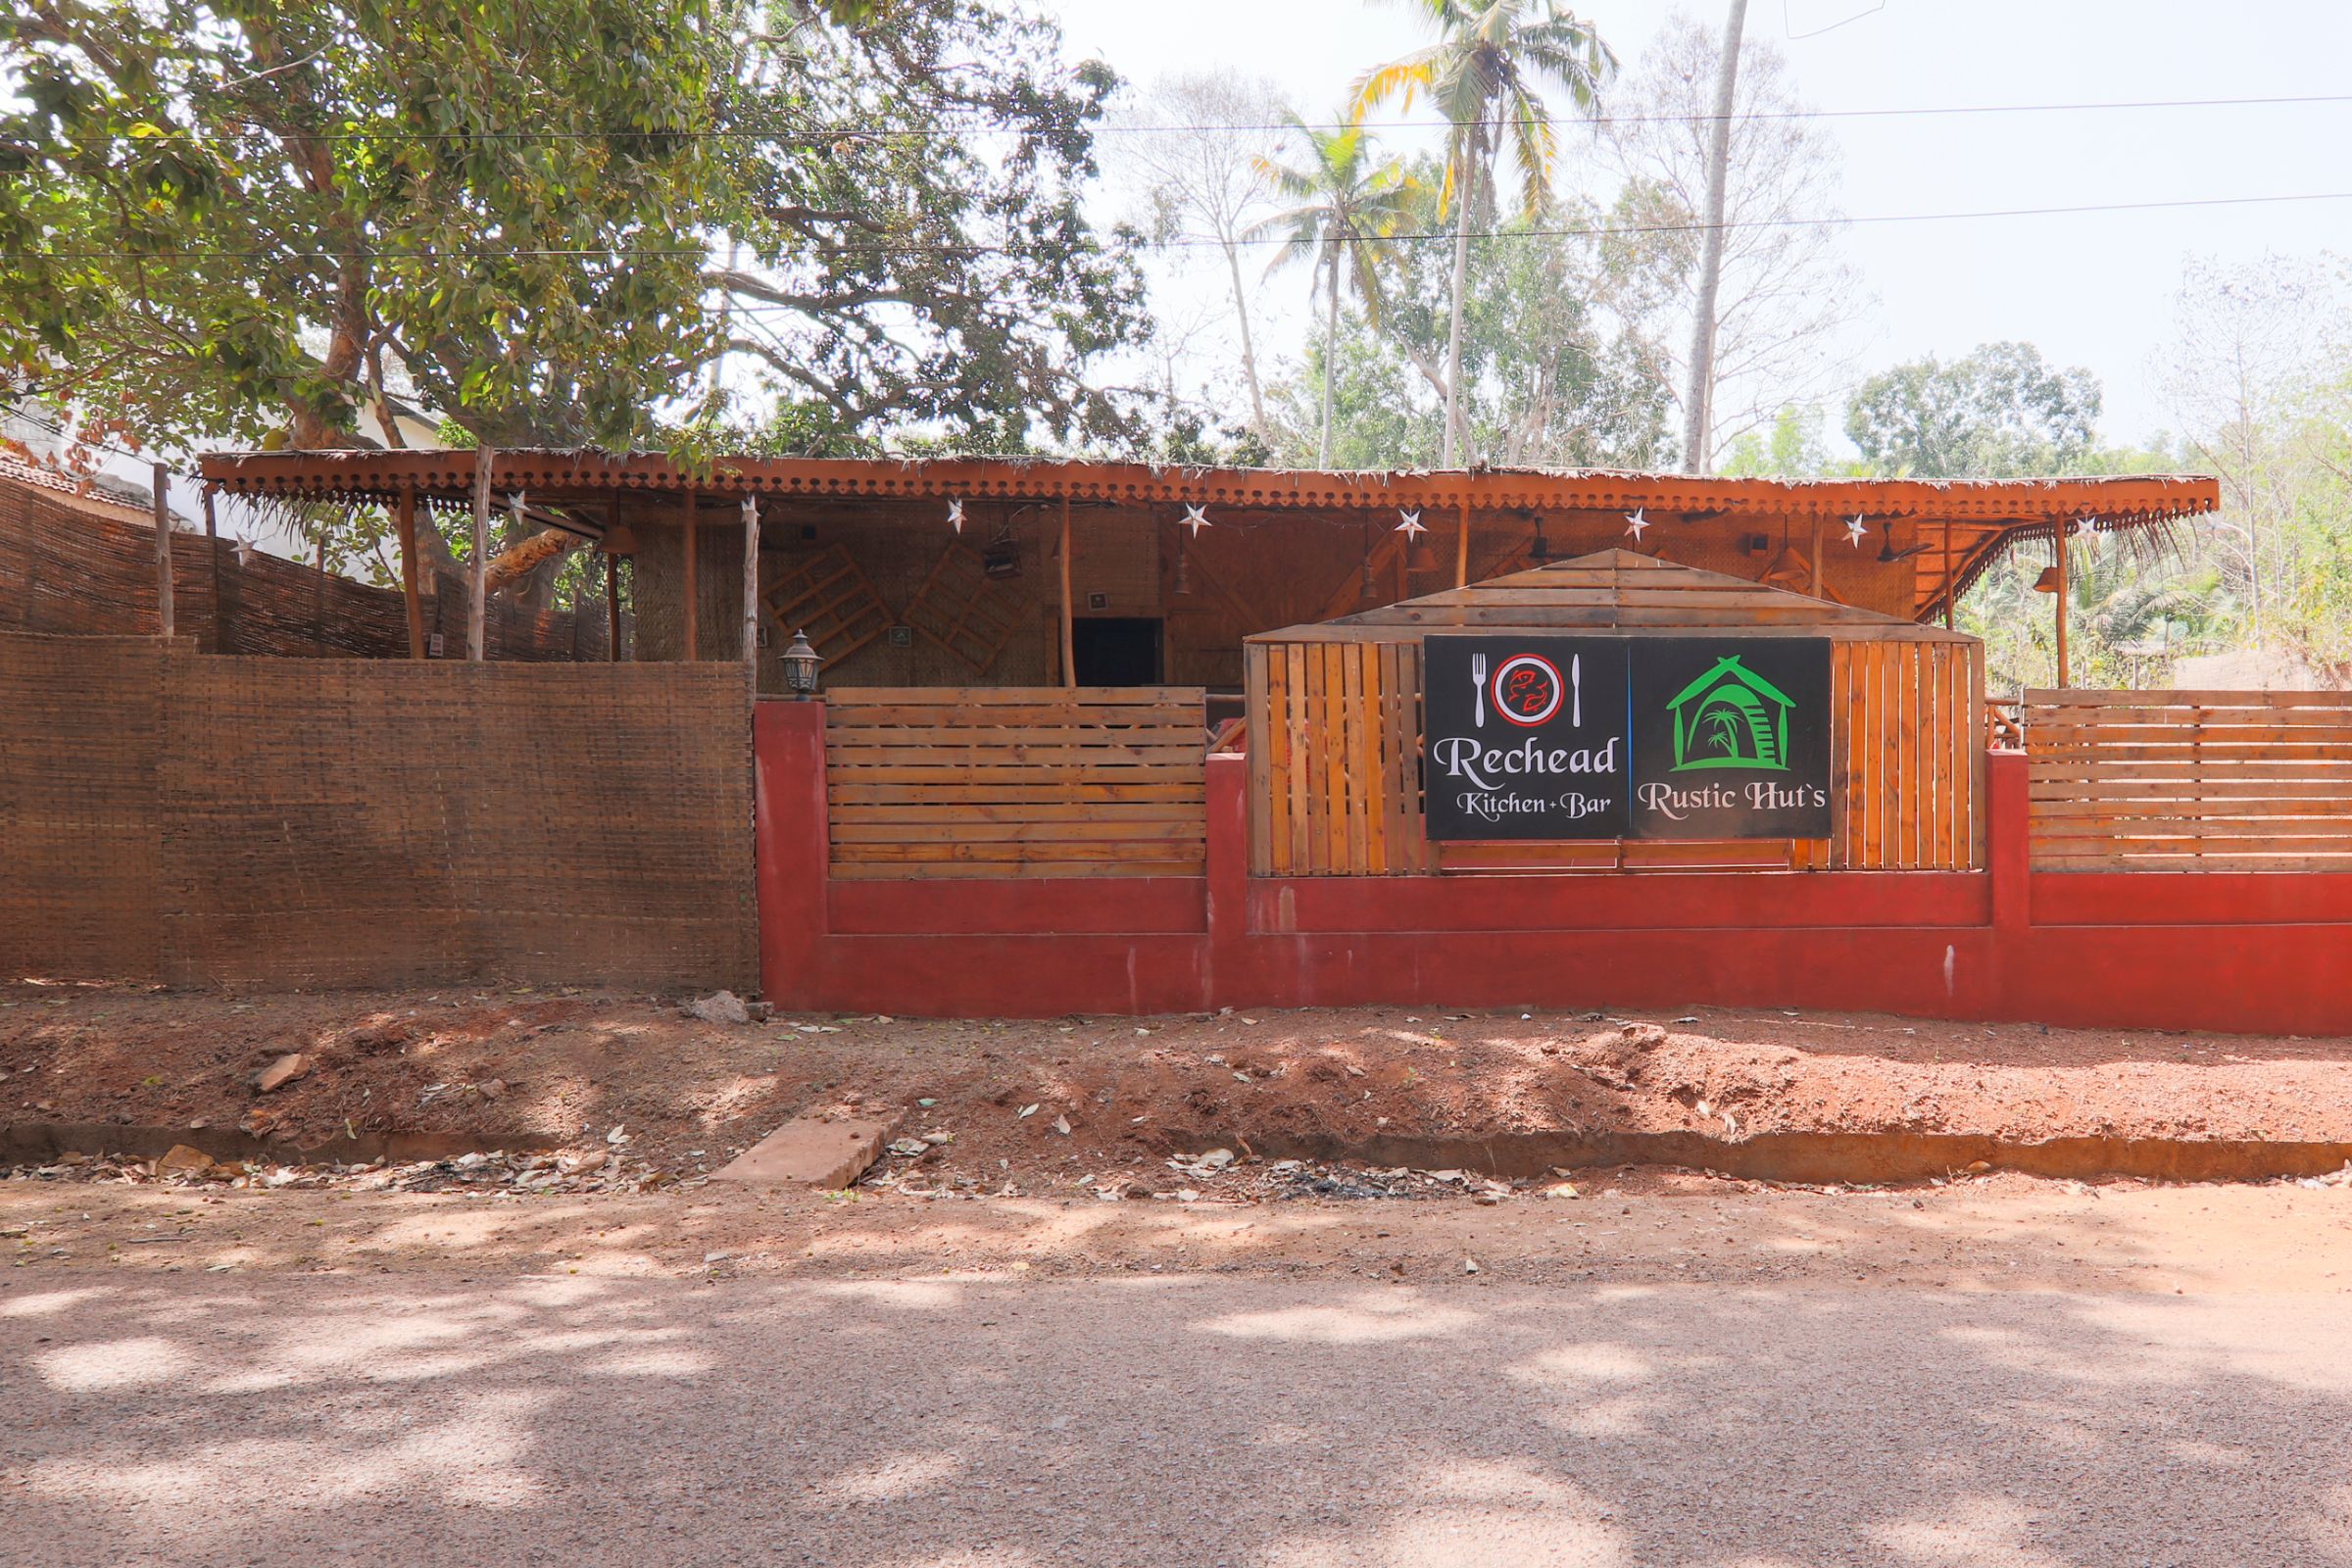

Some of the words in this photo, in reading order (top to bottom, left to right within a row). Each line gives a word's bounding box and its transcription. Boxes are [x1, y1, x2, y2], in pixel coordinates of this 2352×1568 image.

[1433, 736, 1620, 790] Rechead
[1456, 792, 1545, 821] Kitchen
[1559, 792, 1612, 819] Bar
[1638, 782, 1737, 820] Rustic
